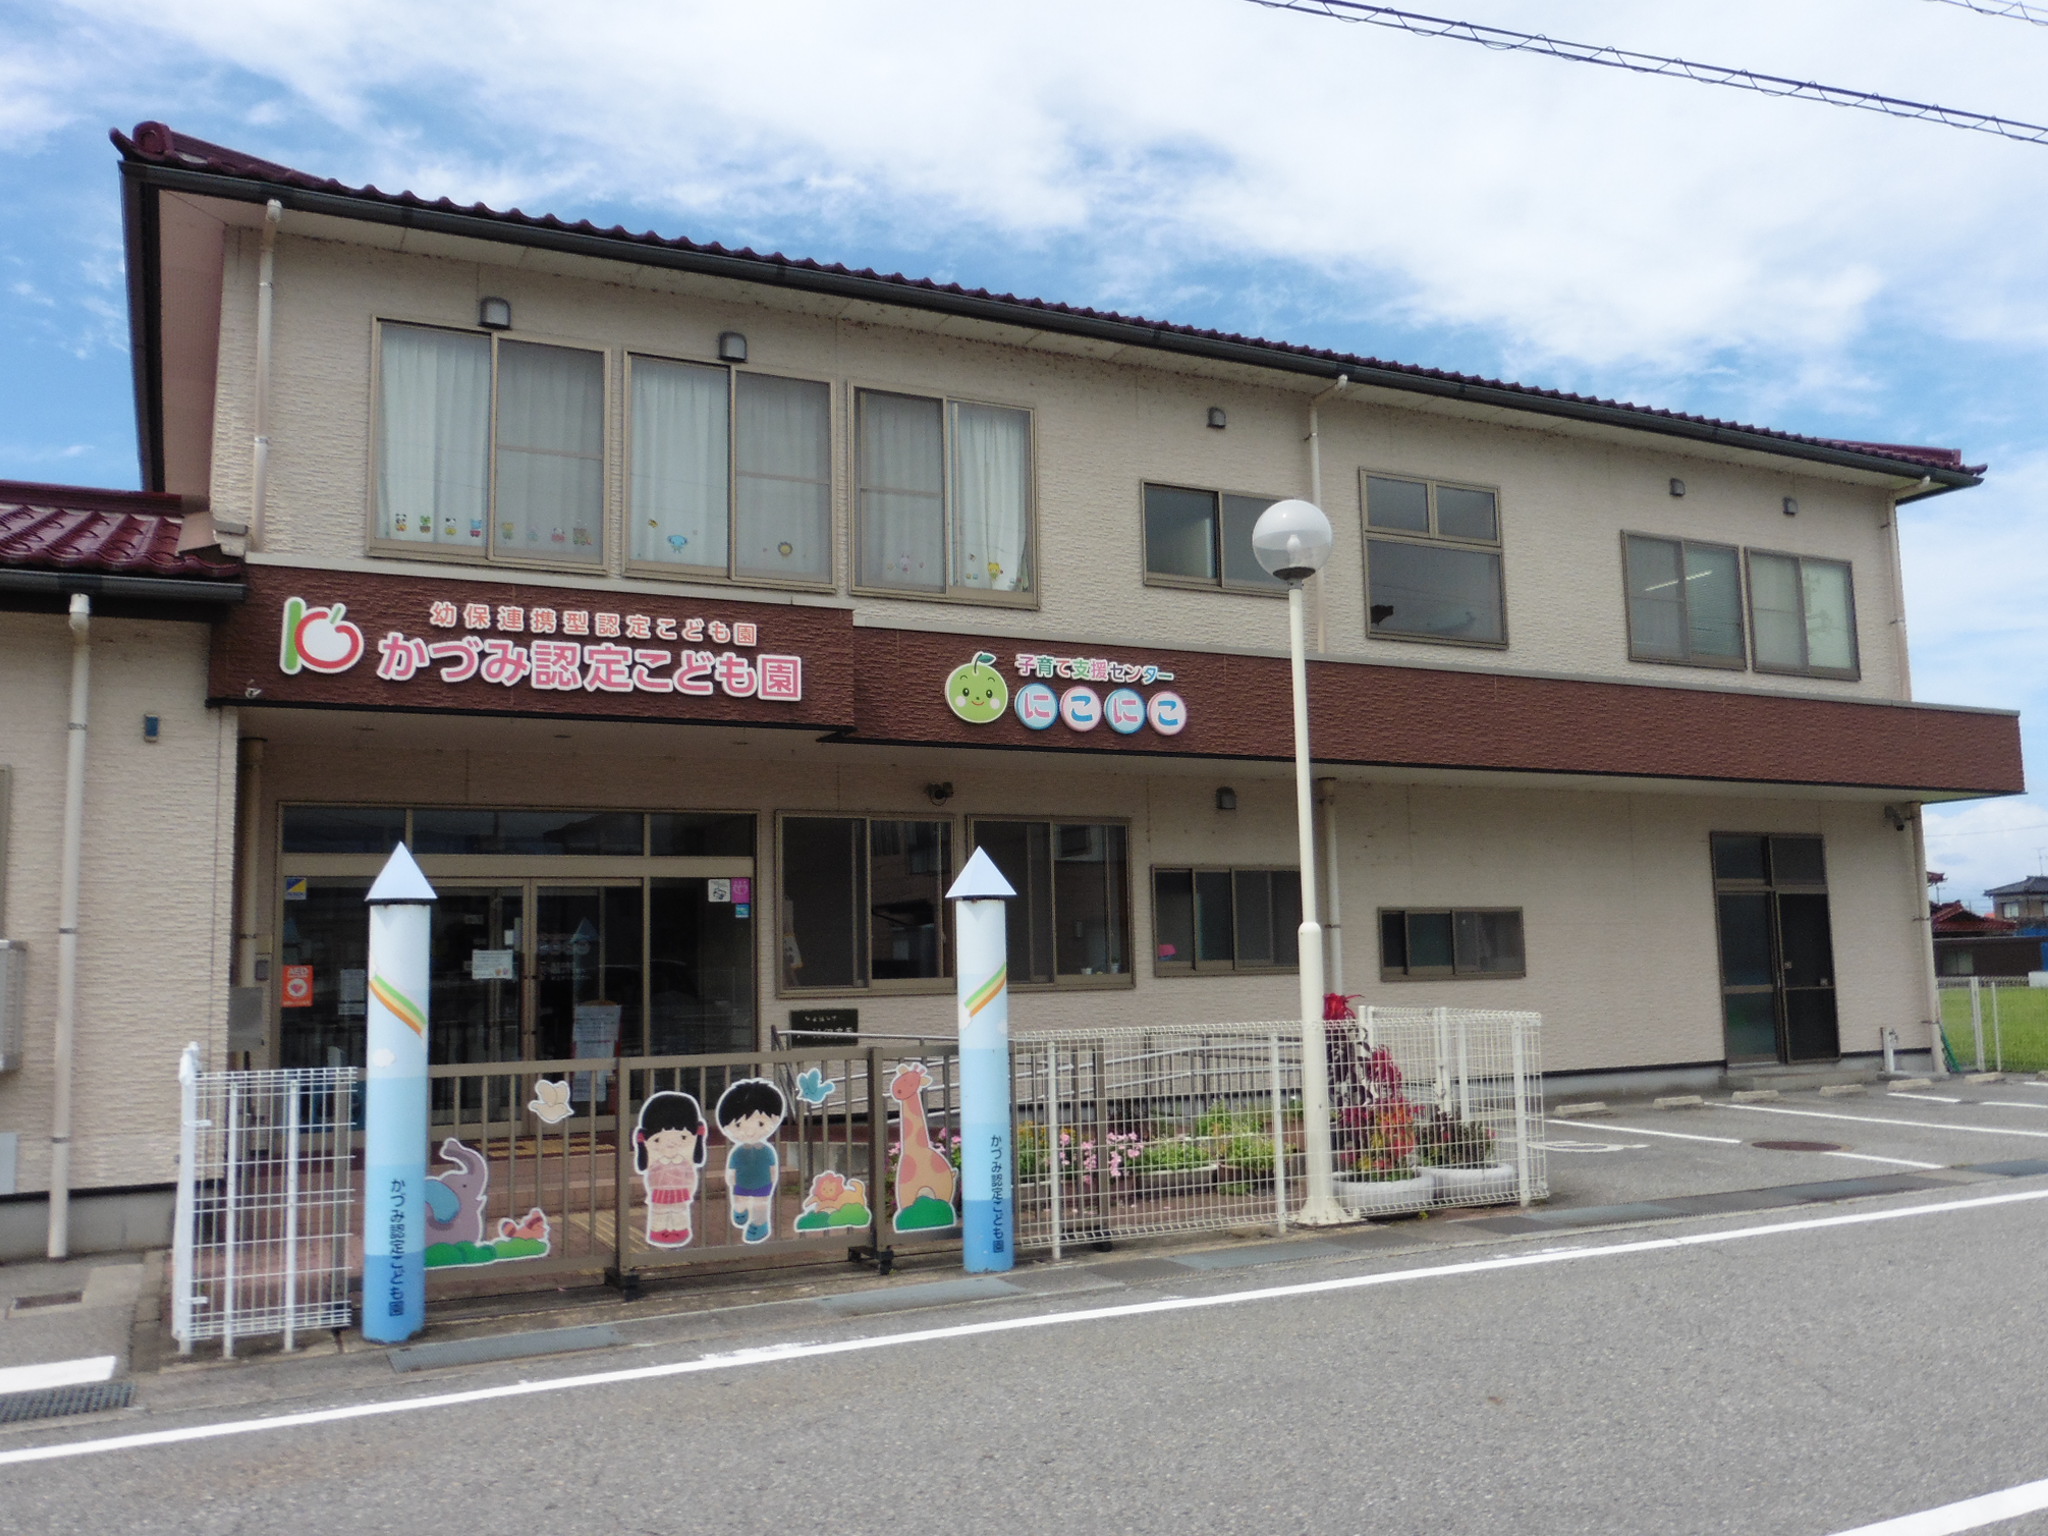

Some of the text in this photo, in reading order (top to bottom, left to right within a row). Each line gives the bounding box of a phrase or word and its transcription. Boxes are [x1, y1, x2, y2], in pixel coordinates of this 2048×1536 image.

[430, 601, 758, 647] 幼保連携型認定こども園
[377, 633, 803, 701] かづみ認定こども園
[1015, 653, 1175, 685] 子育て支援センター
[1020, 688, 1183, 730] にこにこ
[990, 1134, 1004, 1254] かづみ認定こども園
